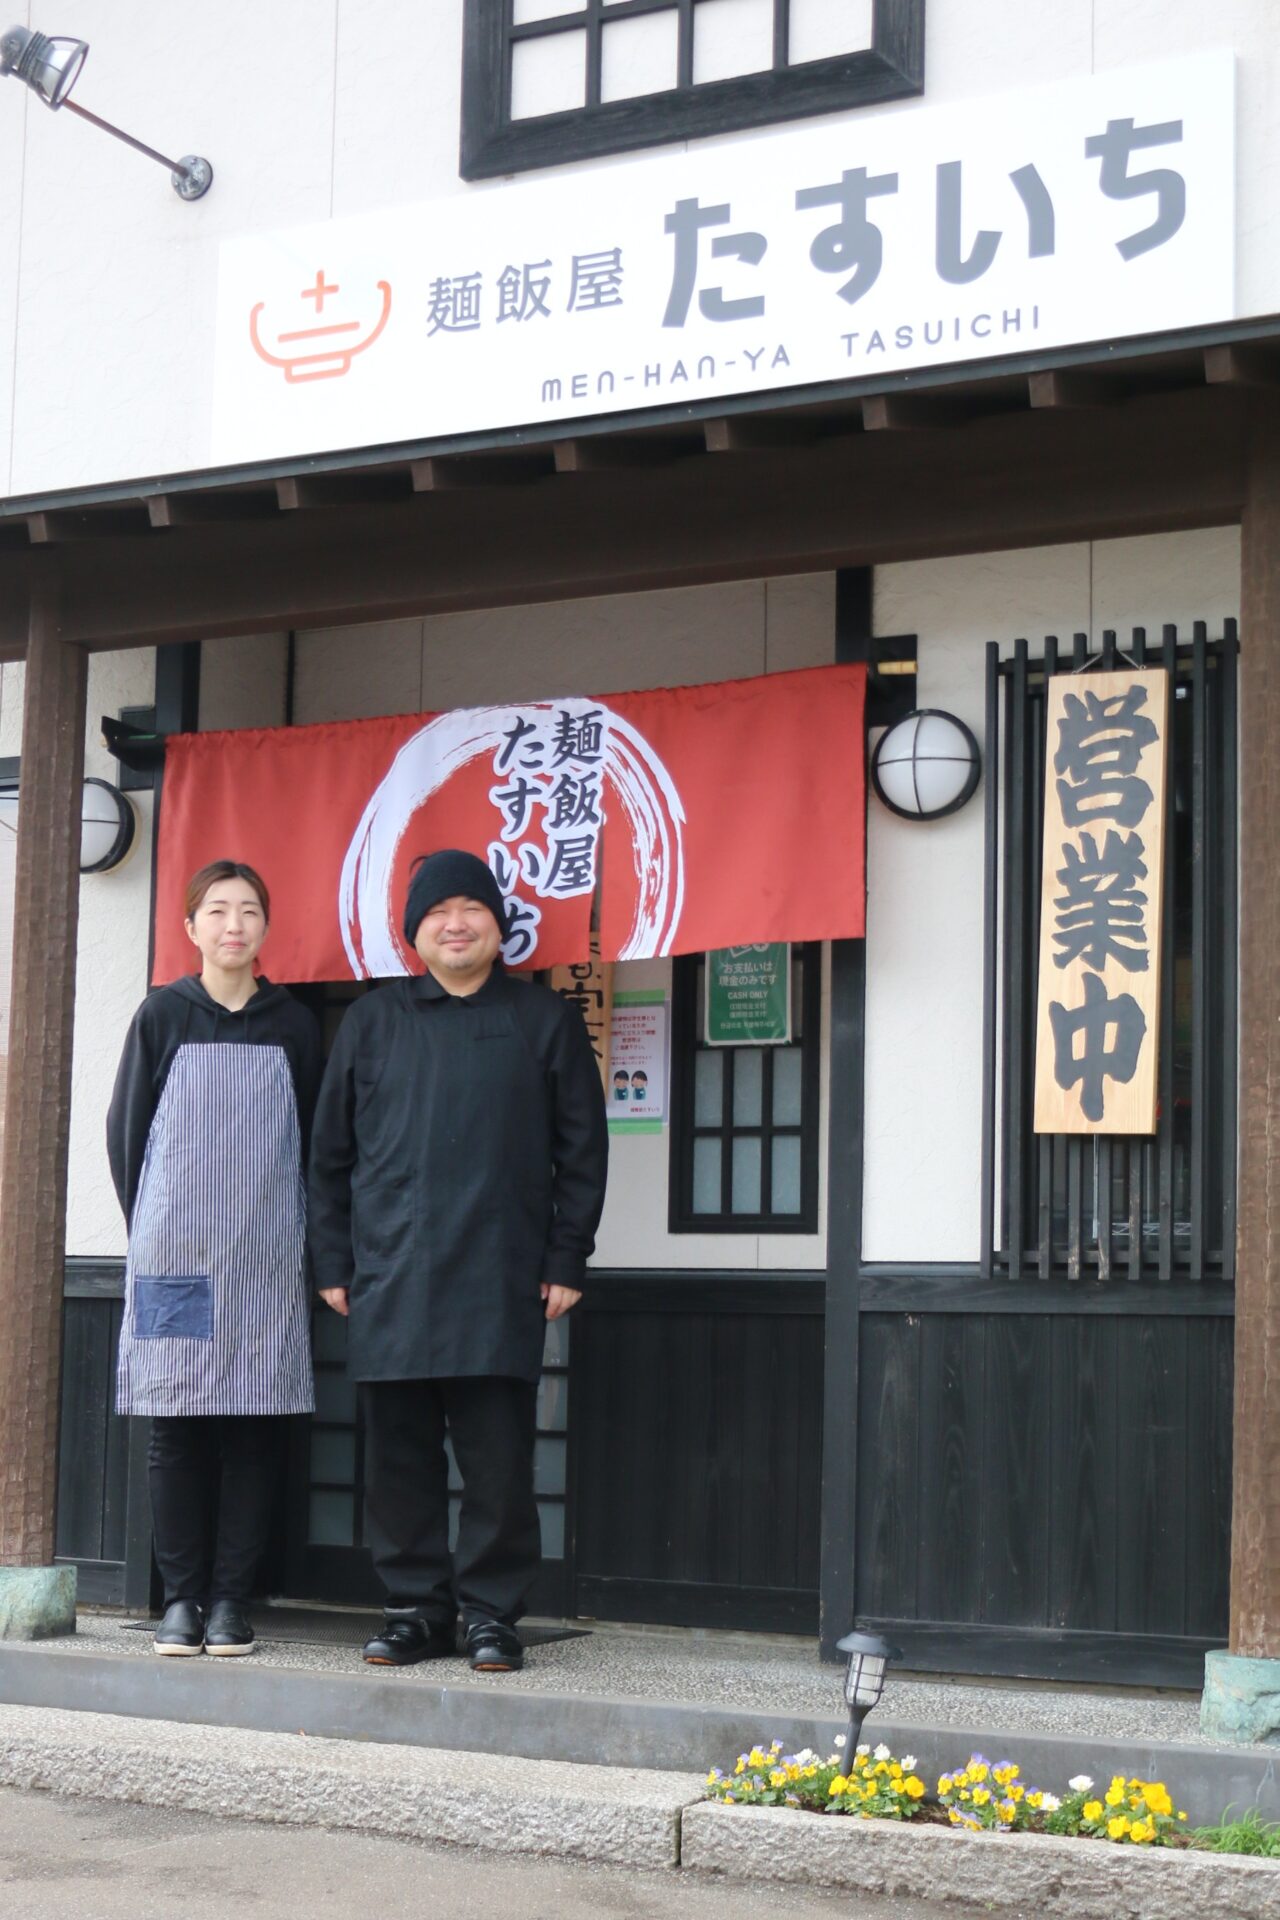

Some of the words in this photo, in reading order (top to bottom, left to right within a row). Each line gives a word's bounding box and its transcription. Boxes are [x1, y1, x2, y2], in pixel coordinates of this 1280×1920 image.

[427, 247, 624, 338] 麺飯屋
[661, 117, 1187, 328] たすいち
[840, 305, 1040, 357] TASUICHI
[495, 715, 545, 959] たすいち
[544, 710, 604, 891] 麺飯屋
[1048, 684, 1160, 1123] 営業中
[719, 974, 776, 987] 現金のみです
[723, 961, 773, 974] お支払いは
[727, 991, 748, 1000] CASH
[749, 990, 768, 999] ONLY
